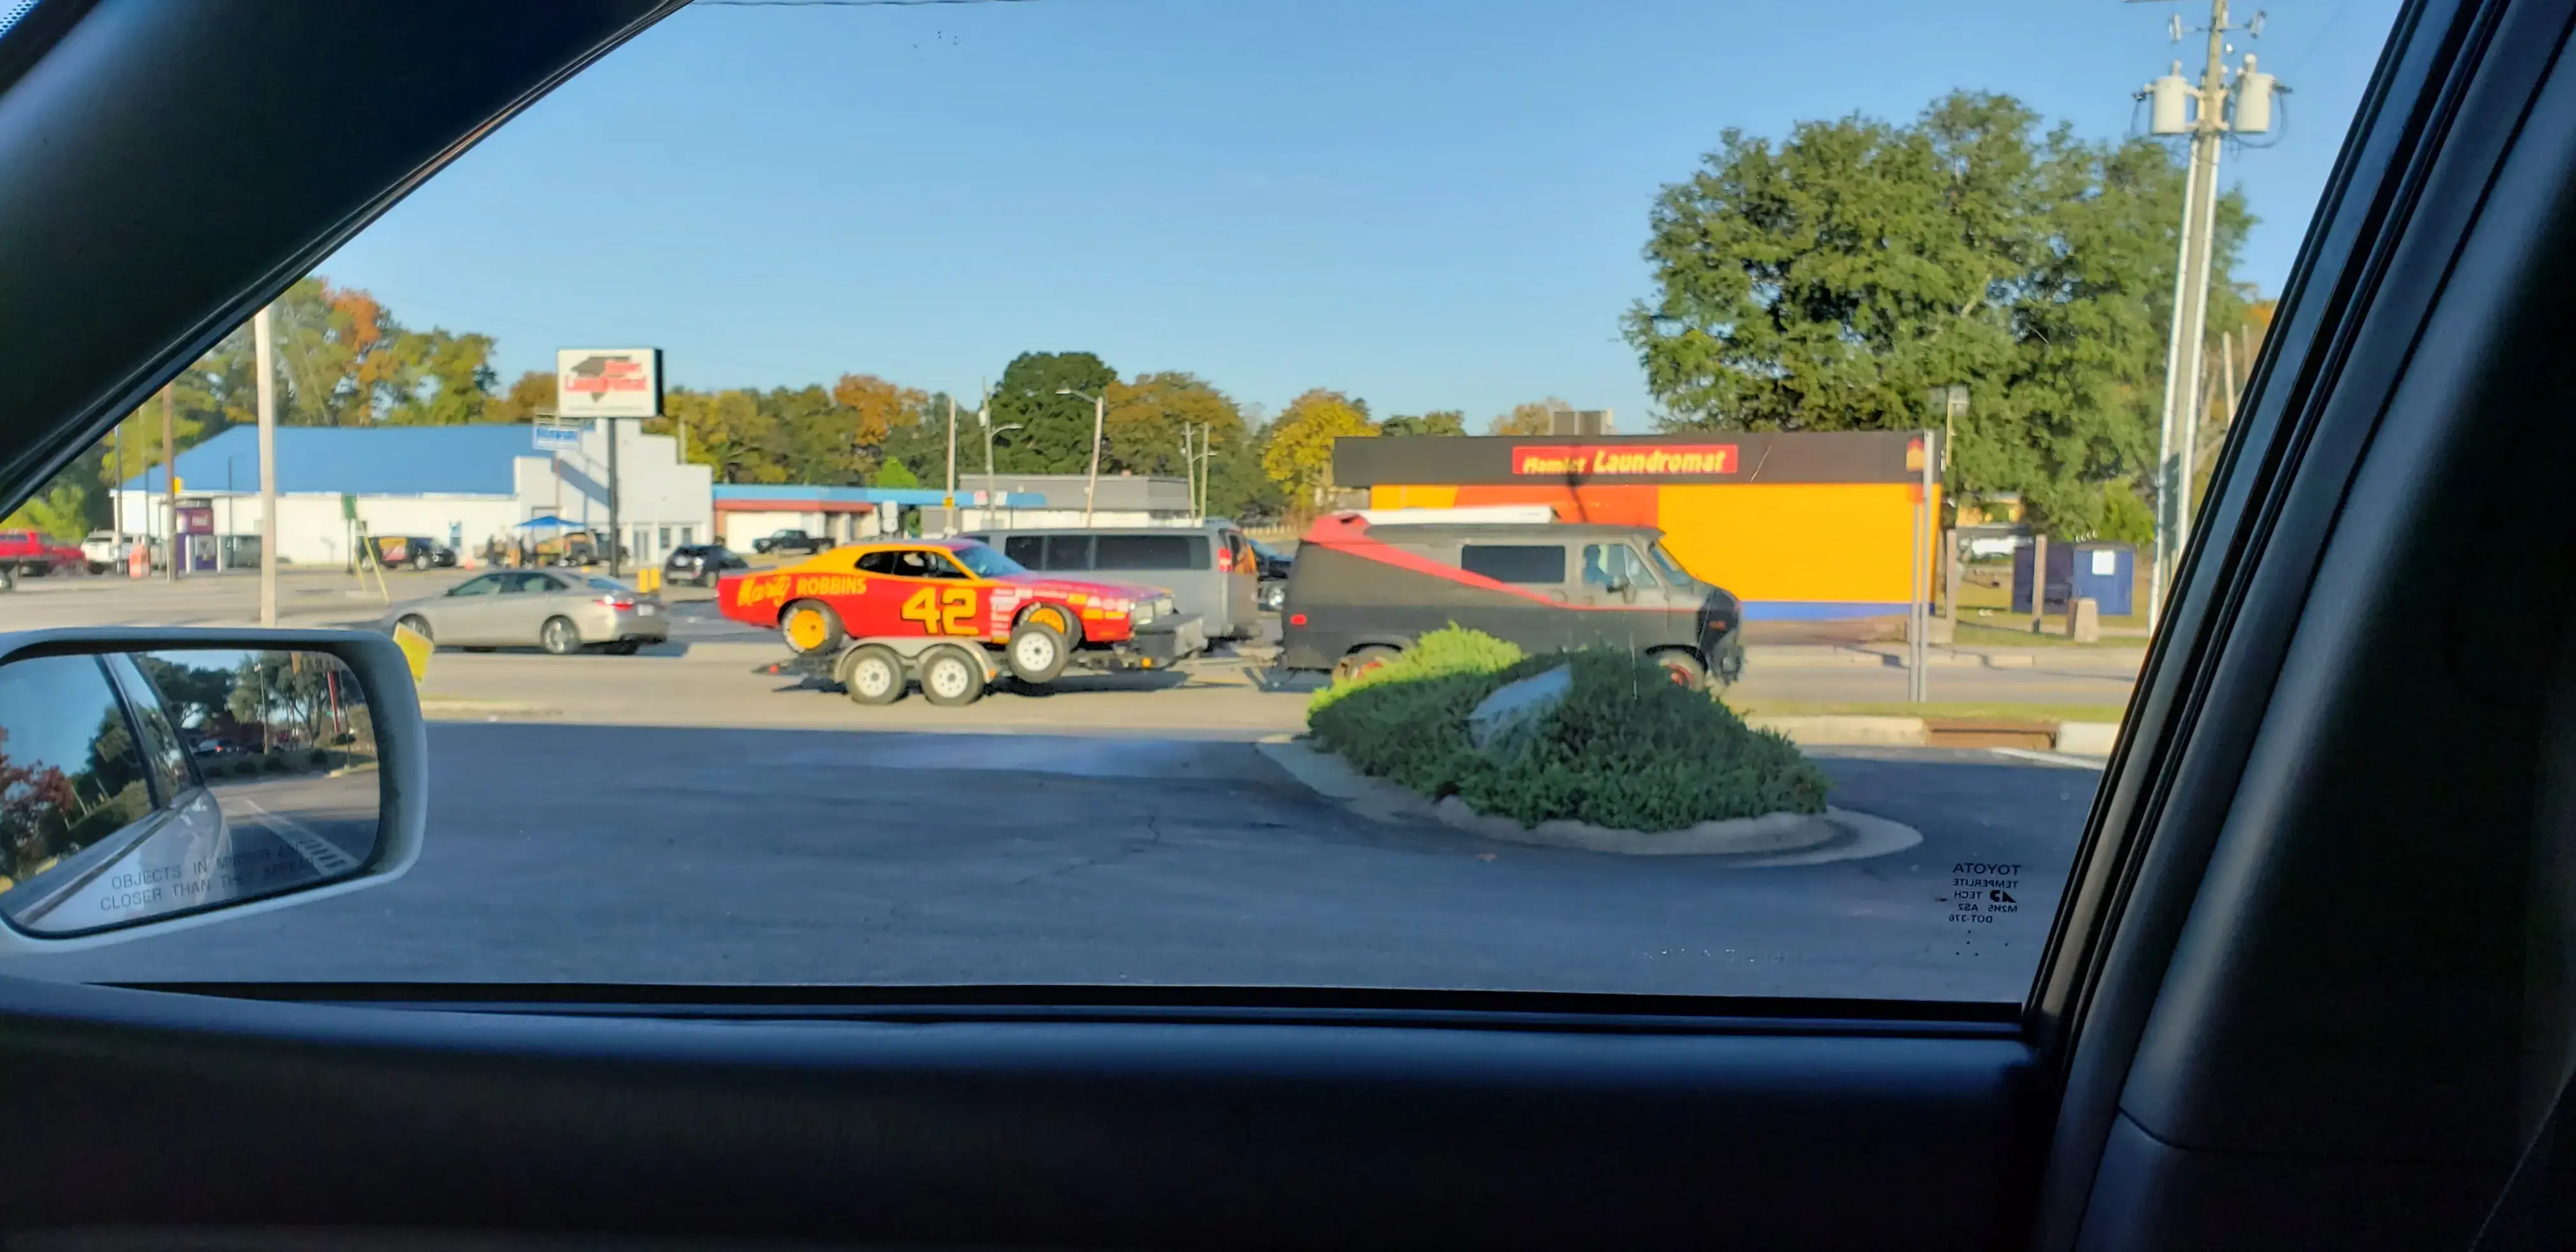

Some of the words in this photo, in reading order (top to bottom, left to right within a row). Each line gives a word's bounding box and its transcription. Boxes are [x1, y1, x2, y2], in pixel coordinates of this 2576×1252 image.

[1593, 449, 1726, 473] Laundromat
[797, 576, 868, 595] ROBBINS
[900, 586, 980, 636] 42
[111, 865, 181, 889] OBJECTS
[193, 860, 207, 874] IN
[100, 887, 162, 911] CLOSER
[172, 878, 211, 897] THAN
